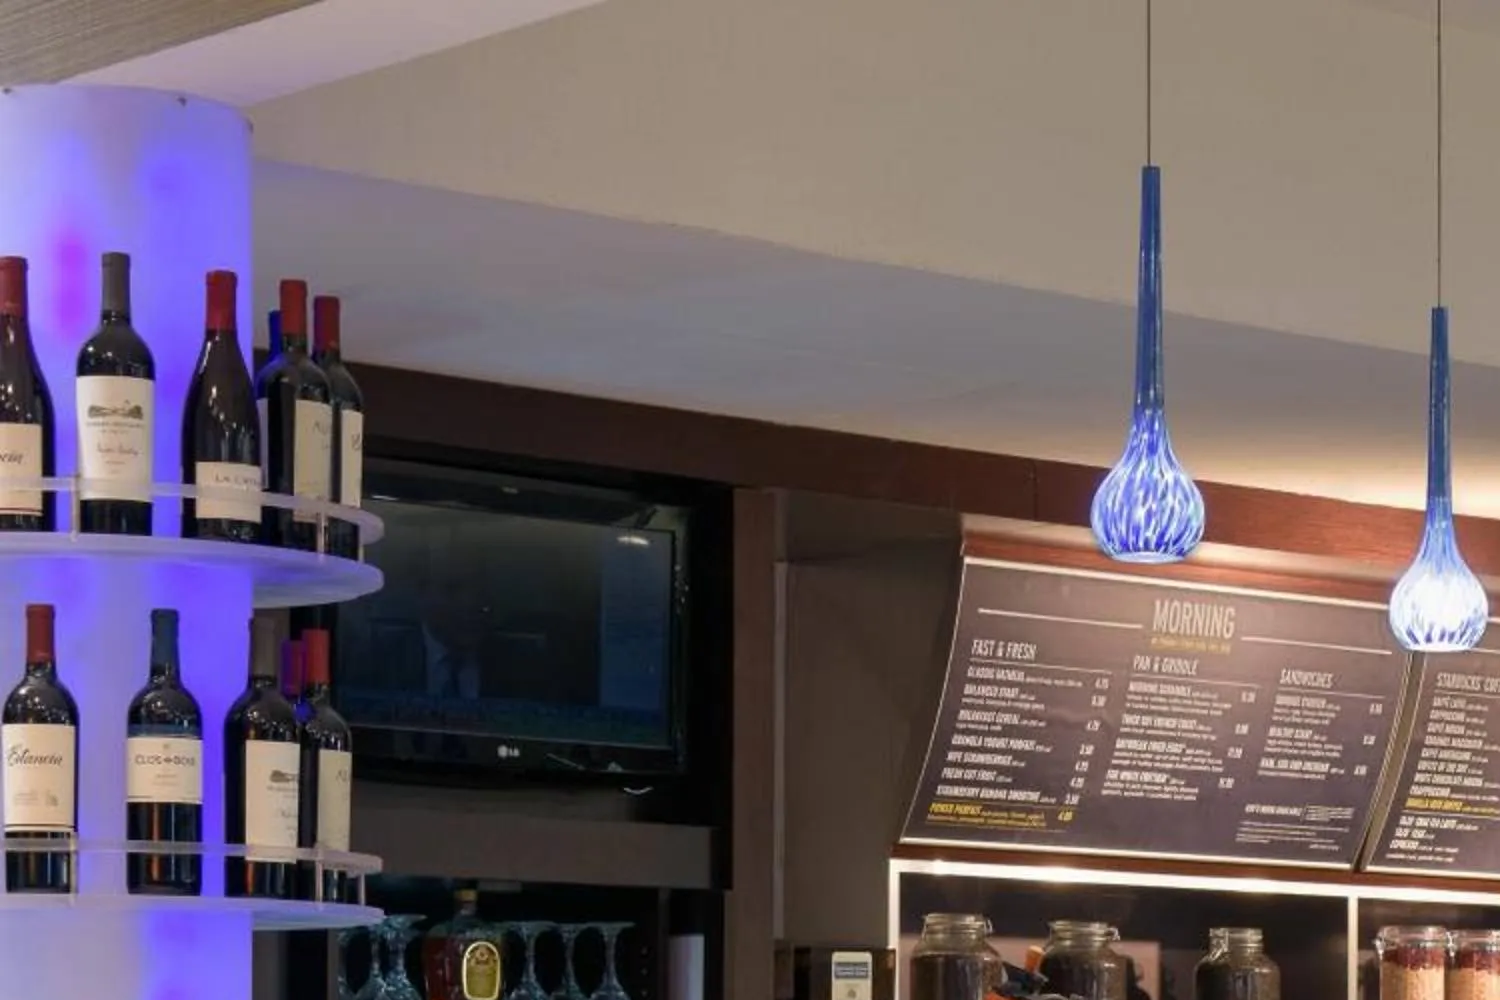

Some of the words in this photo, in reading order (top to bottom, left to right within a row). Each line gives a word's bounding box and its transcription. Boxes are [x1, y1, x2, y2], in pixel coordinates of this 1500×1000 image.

[1153, 599, 1236, 639] MORNING
[971, 639, 995, 657] FAST
[1005, 643, 1037, 660] FRESH
[1132, 655, 1151, 671] PAN
